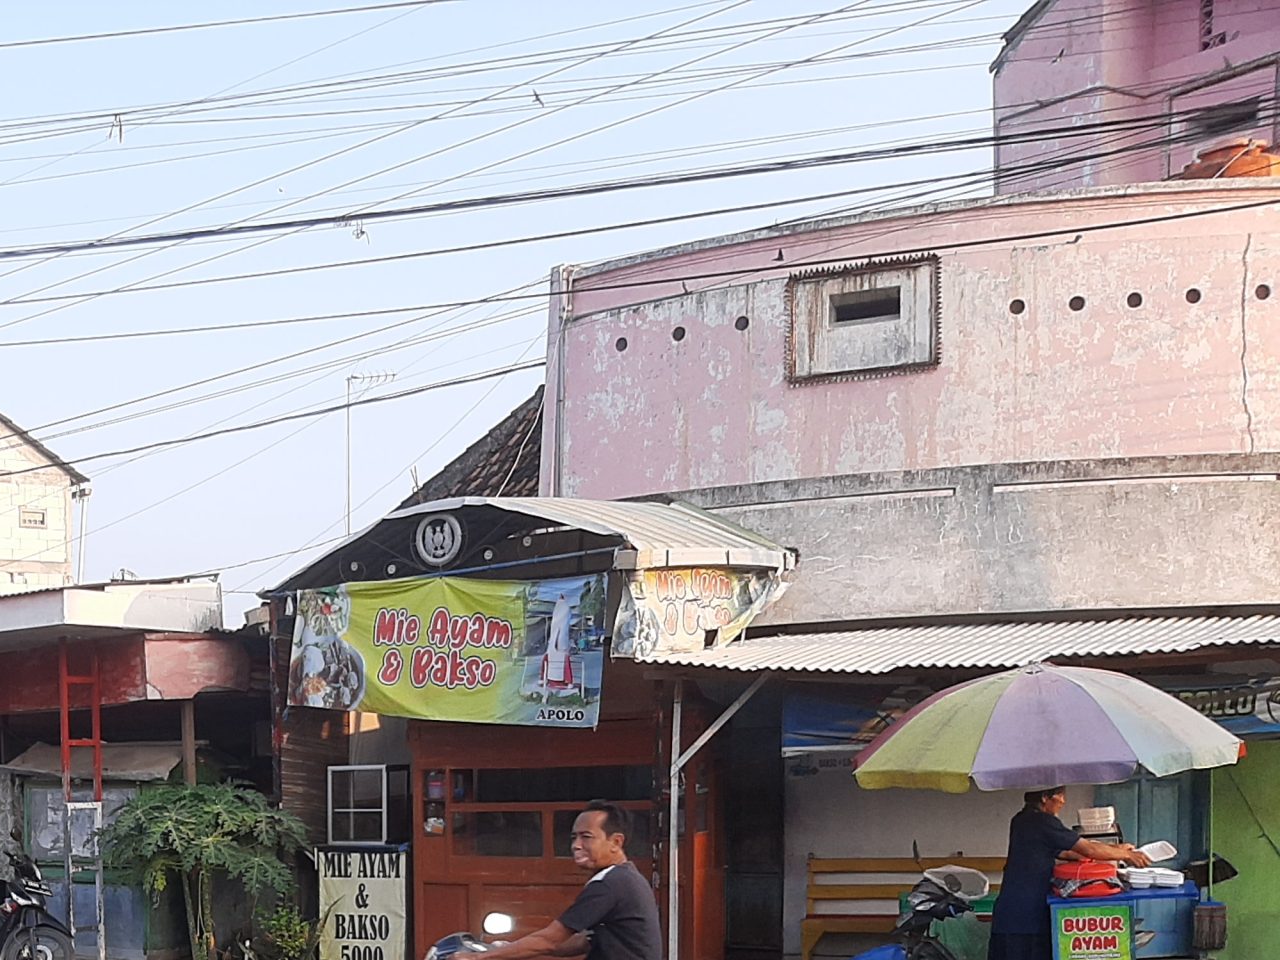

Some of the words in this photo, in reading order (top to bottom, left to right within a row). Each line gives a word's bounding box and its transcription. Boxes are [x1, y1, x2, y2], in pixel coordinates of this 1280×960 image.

[656, 570, 687, 602] Mie
[375, 607, 419, 647] Mie
[428, 607, 512, 649] Ayam
[378, 648, 403, 685] &
[410, 648, 496, 688] Bakso
[537, 708, 585, 722] APOLO
[324, 853, 353, 878] MIE
[357, 853, 401, 878] AYAM
[355, 883, 370, 909] &
[334, 914, 390, 941] BAKSO
[1063, 916, 1125, 933] BUBUR
[1071, 935, 1118, 951] AYAM
